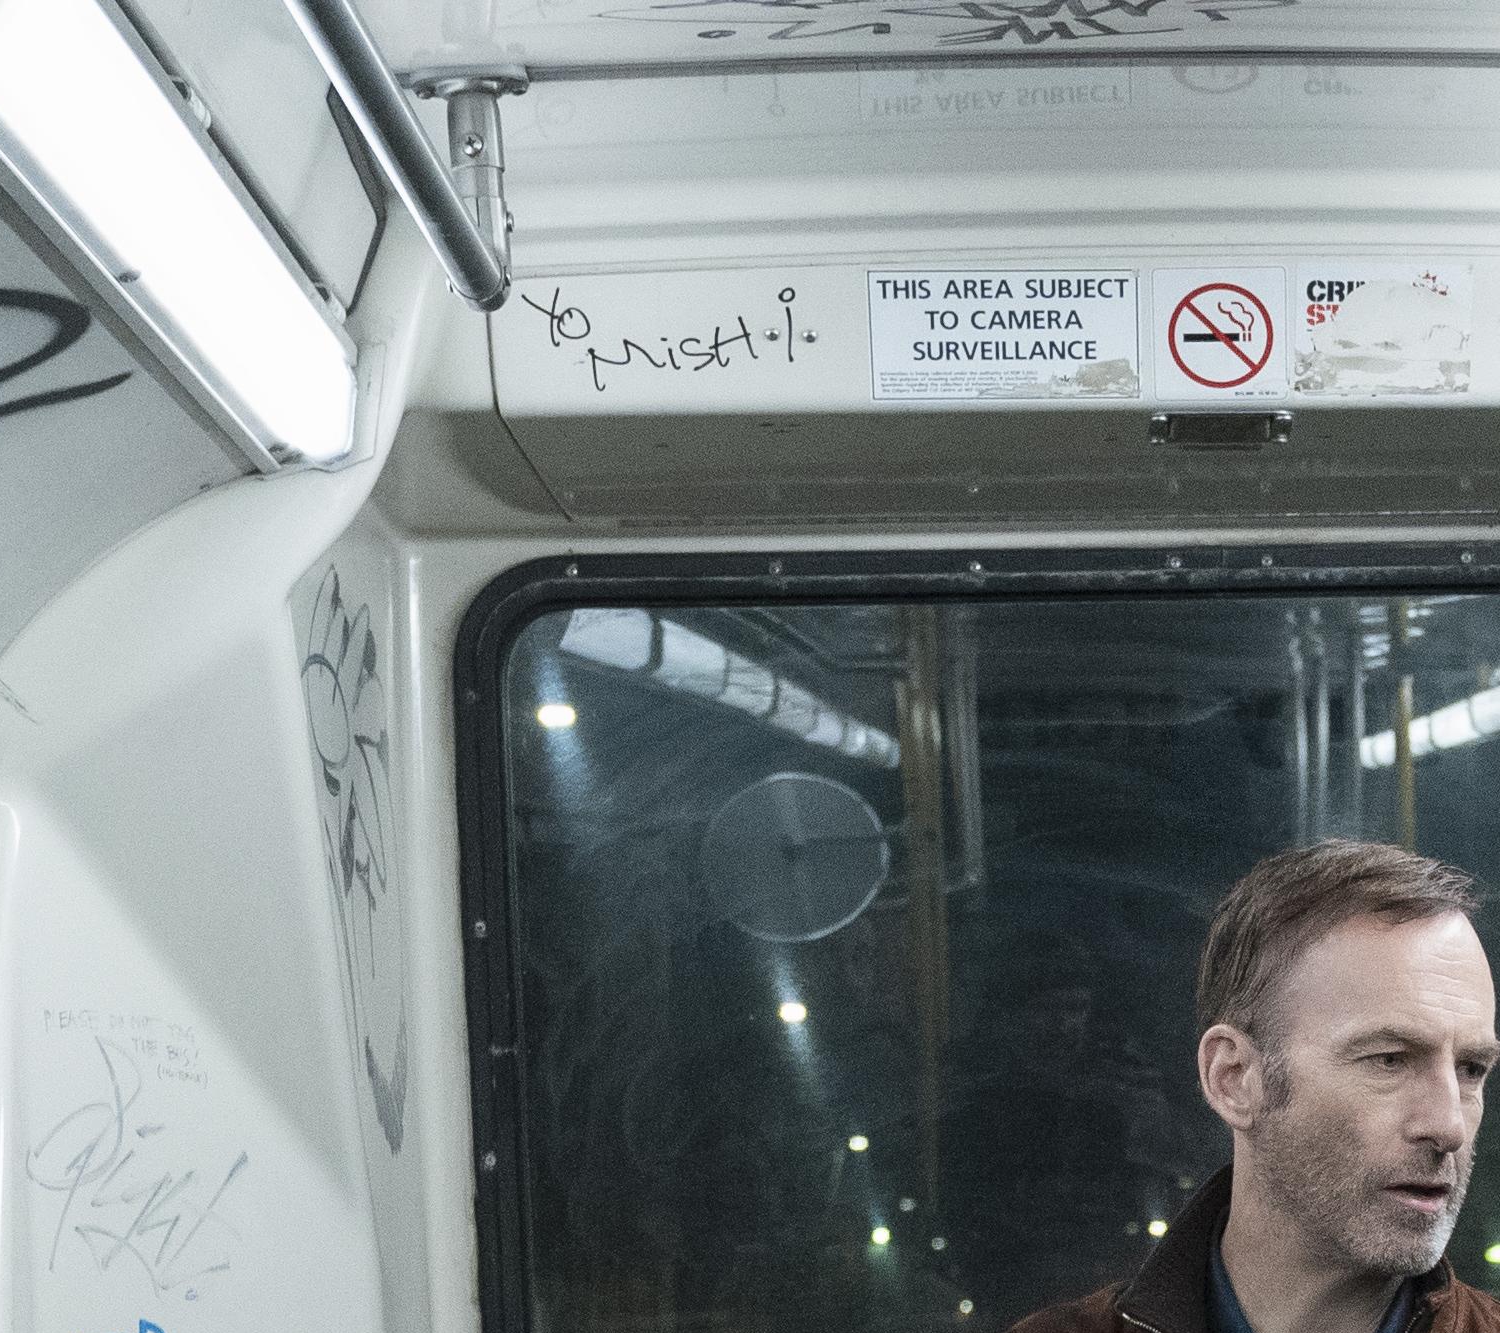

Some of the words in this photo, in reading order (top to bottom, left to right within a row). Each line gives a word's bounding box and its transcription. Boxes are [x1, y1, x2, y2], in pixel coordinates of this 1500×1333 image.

[876, 279, 931, 299] THIS
[943, 279, 1013, 299] AREA
[1025, 278, 1129, 298] SUBJECT
[925, 310, 959, 330] TO
[970, 309, 1083, 330] CAMERA
[913, 340, 1097, 361] SURVEILLANCE
[43, 1009, 99, 1034] PEASE
